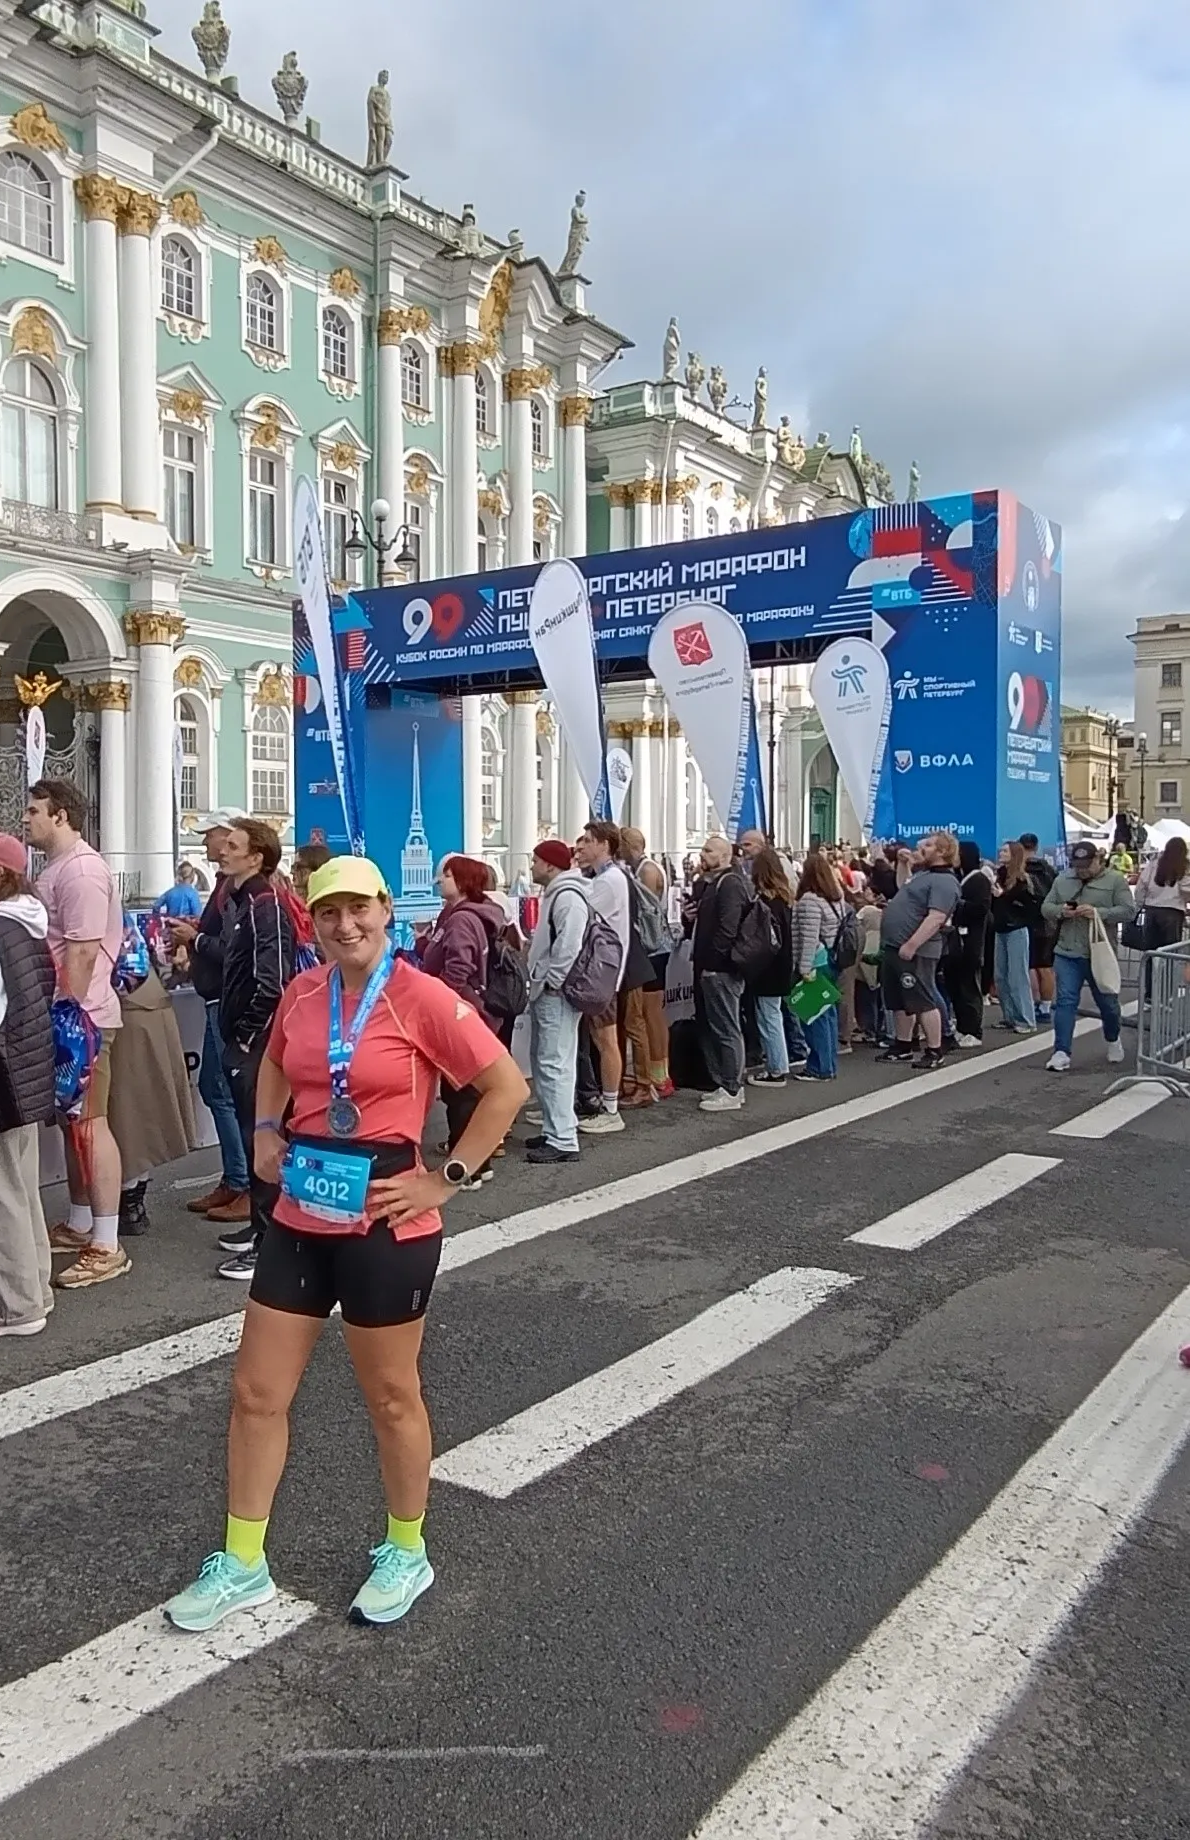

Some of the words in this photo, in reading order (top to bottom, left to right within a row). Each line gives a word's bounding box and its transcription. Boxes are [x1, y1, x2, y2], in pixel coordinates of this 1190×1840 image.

[498, 561, 672, 610] ПЕТРГСКИЙ
[681, 546, 806, 584] МАРАФОН
[891, 588, 913, 601] ВТБ
[396, 651, 427, 664] КУБОК
[429, 647, 467, 661] РОССИИ
[470, 644, 484, 655] ПО
[486, 639, 532, 654] МАРАФО
[618, 624, 656, 638] САНКТ-
[746, 604, 815, 623] МАРАФОНУ
[920, 753, 974, 768] ВФЛА
[304, 1175, 350, 1201] 4012
